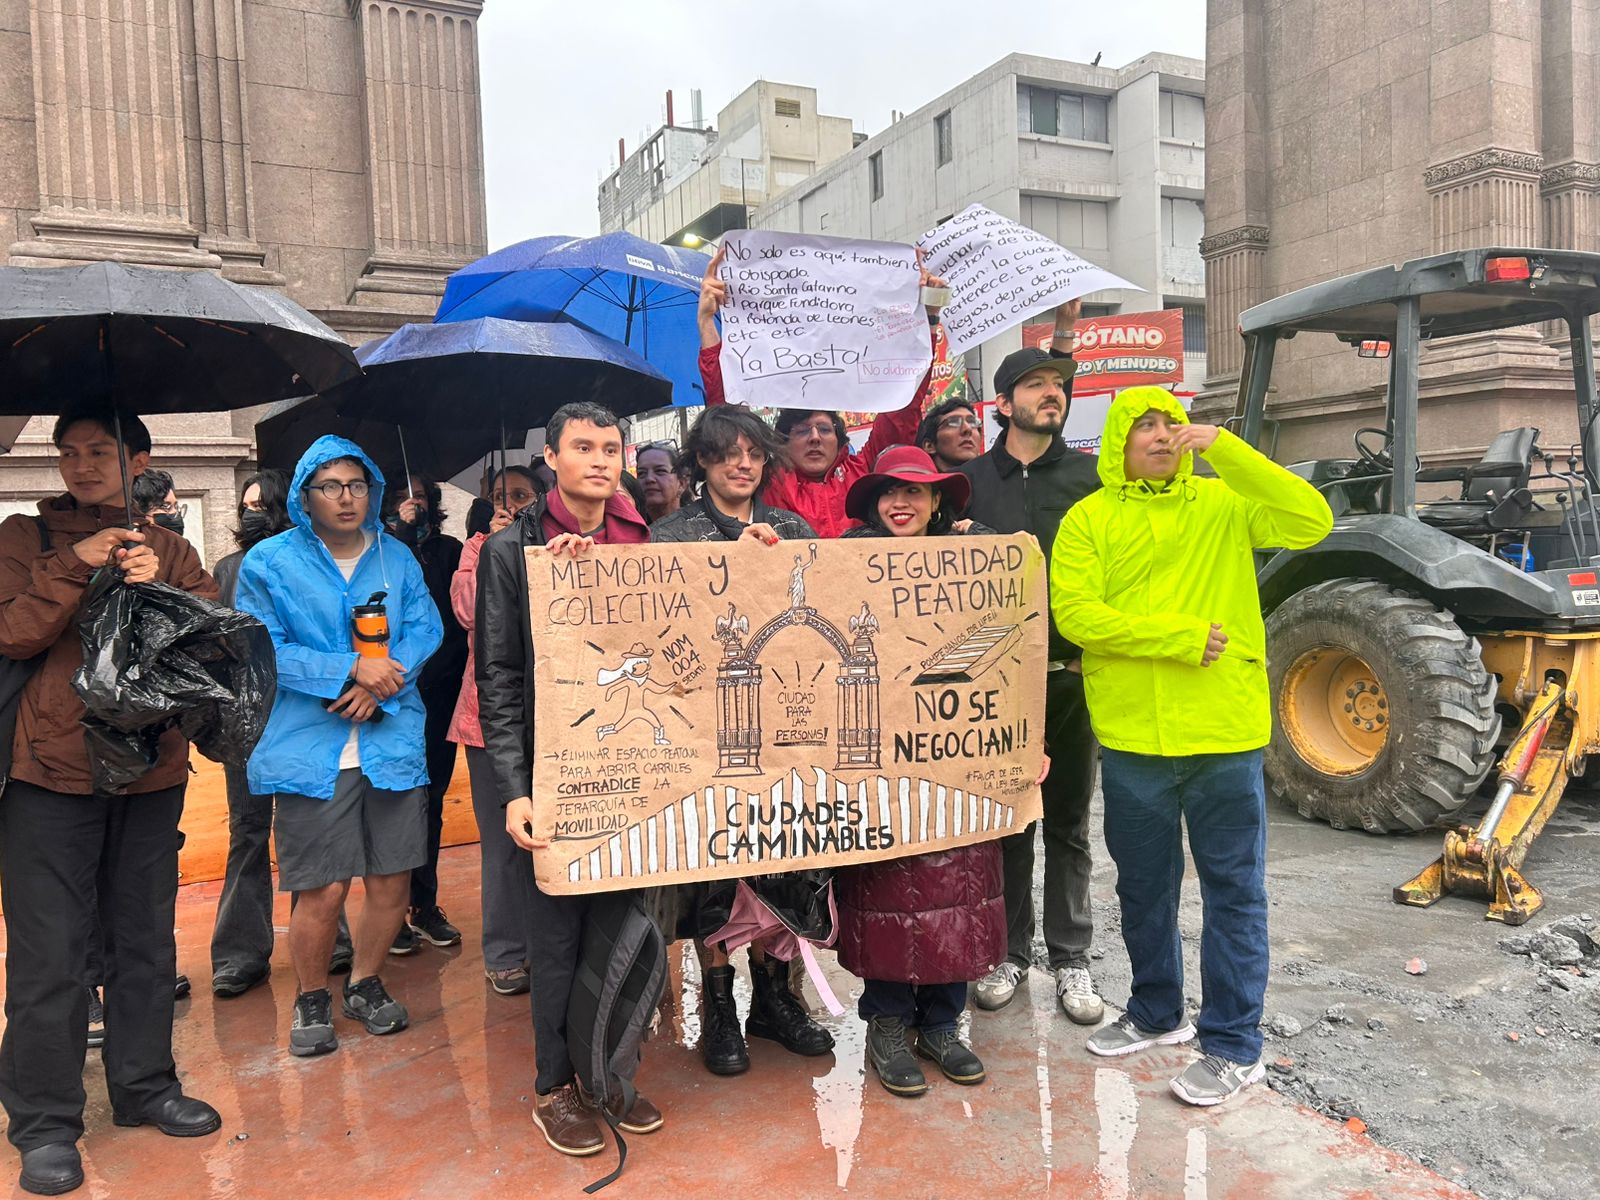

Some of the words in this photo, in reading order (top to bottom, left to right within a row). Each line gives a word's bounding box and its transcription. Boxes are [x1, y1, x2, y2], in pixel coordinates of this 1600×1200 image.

[997, 236, 1018, 246] de
[724, 239, 752, 261] No
[759, 244, 784, 259] solo
[789, 247, 806, 257] es
[851, 252, 909, 270] tambien
[720, 266, 734, 282] El
[991, 258, 1010, 271] la
[1015, 264, 1034, 275] Es
[1040, 256, 1057, 267] de
[763, 283, 798, 296] Santa
[994, 285, 1024, 305] deja
[1031, 273, 1050, 287] de
[806, 313, 824, 323] de
[957, 312, 1008, 343] nuestra
[727, 329, 760, 343] etc
[731, 345, 763, 375] Ya
[773, 343, 869, 370] Basta!
[1094, 358, 1107, 371] Y
[1107, 357, 1177, 371] MENUDEO
[862, 363, 881, 376] No
[551, 555, 687, 590] MEMORIA
[866, 544, 1024, 584] SEGURIDAD
[892, 577, 1027, 619] PEATONAL
[547, 591, 693, 627] COLECTIVA
[661, 633, 694, 663] NOM
[671, 649, 701, 676] 004
[777, 691, 816, 705] CIUDAD
[914, 688, 961, 724] NO
[968, 689, 1000, 723] SE
[785, 705, 812, 718] PARA
[791, 717, 808, 728] LAS
[893, 718, 1028, 764] NEGOCIAN!!
[560, 746, 611, 762] ELIMINAR
[616, 747, 658, 761] ESPACIO
[560, 764, 592, 779] PARA
[596, 762, 639, 778] ABRIR
[643, 761, 693, 776] CARRILES
[556, 776, 641, 795] CONTRADICE
[653, 777, 671, 791] LA
[631, 796, 649, 808] DE
[725, 799, 864, 828] CIUDADES
[554, 813, 630, 837] MOVILIDAD
[707, 824, 896, 861] CAMINABLES
